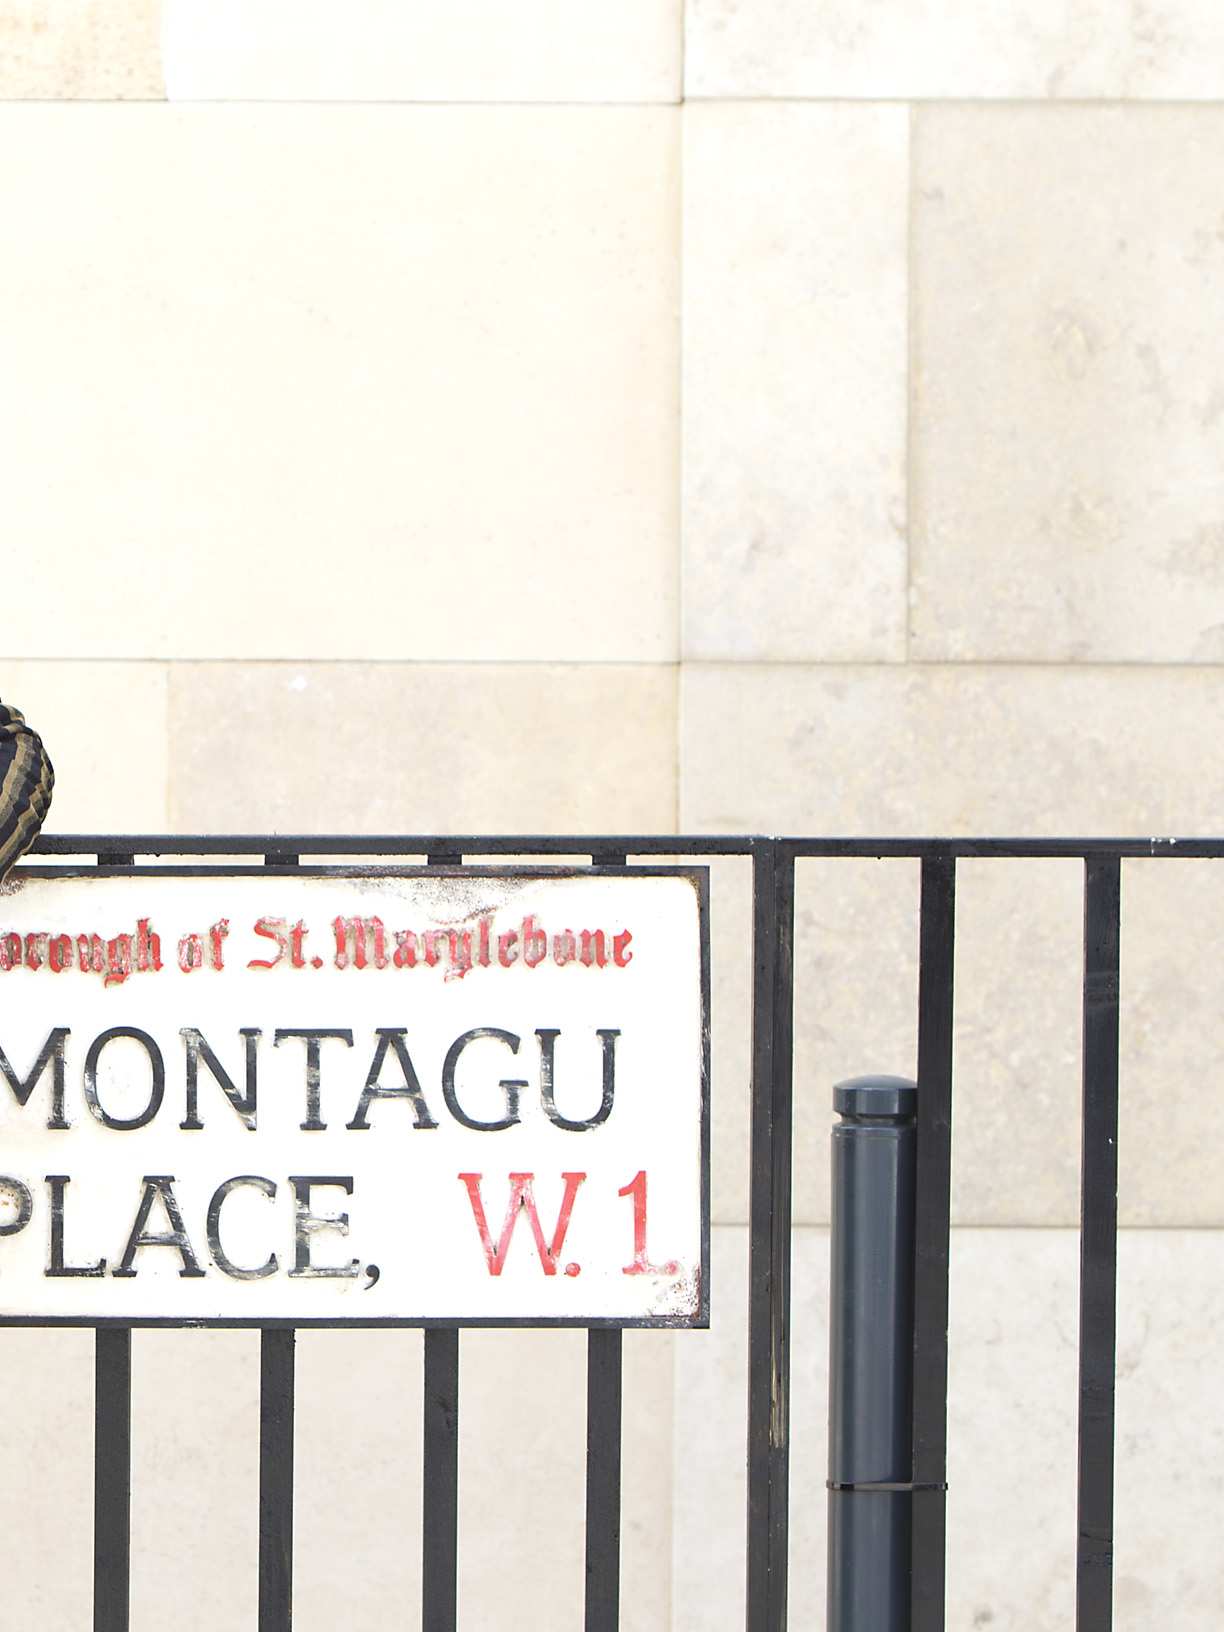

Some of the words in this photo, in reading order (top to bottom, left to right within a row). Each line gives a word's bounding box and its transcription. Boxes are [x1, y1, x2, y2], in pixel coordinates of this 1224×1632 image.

[178, 917, 230, 974] of
[246, 915, 324, 970] St.
[332, 913, 633, 984] Marylebone
